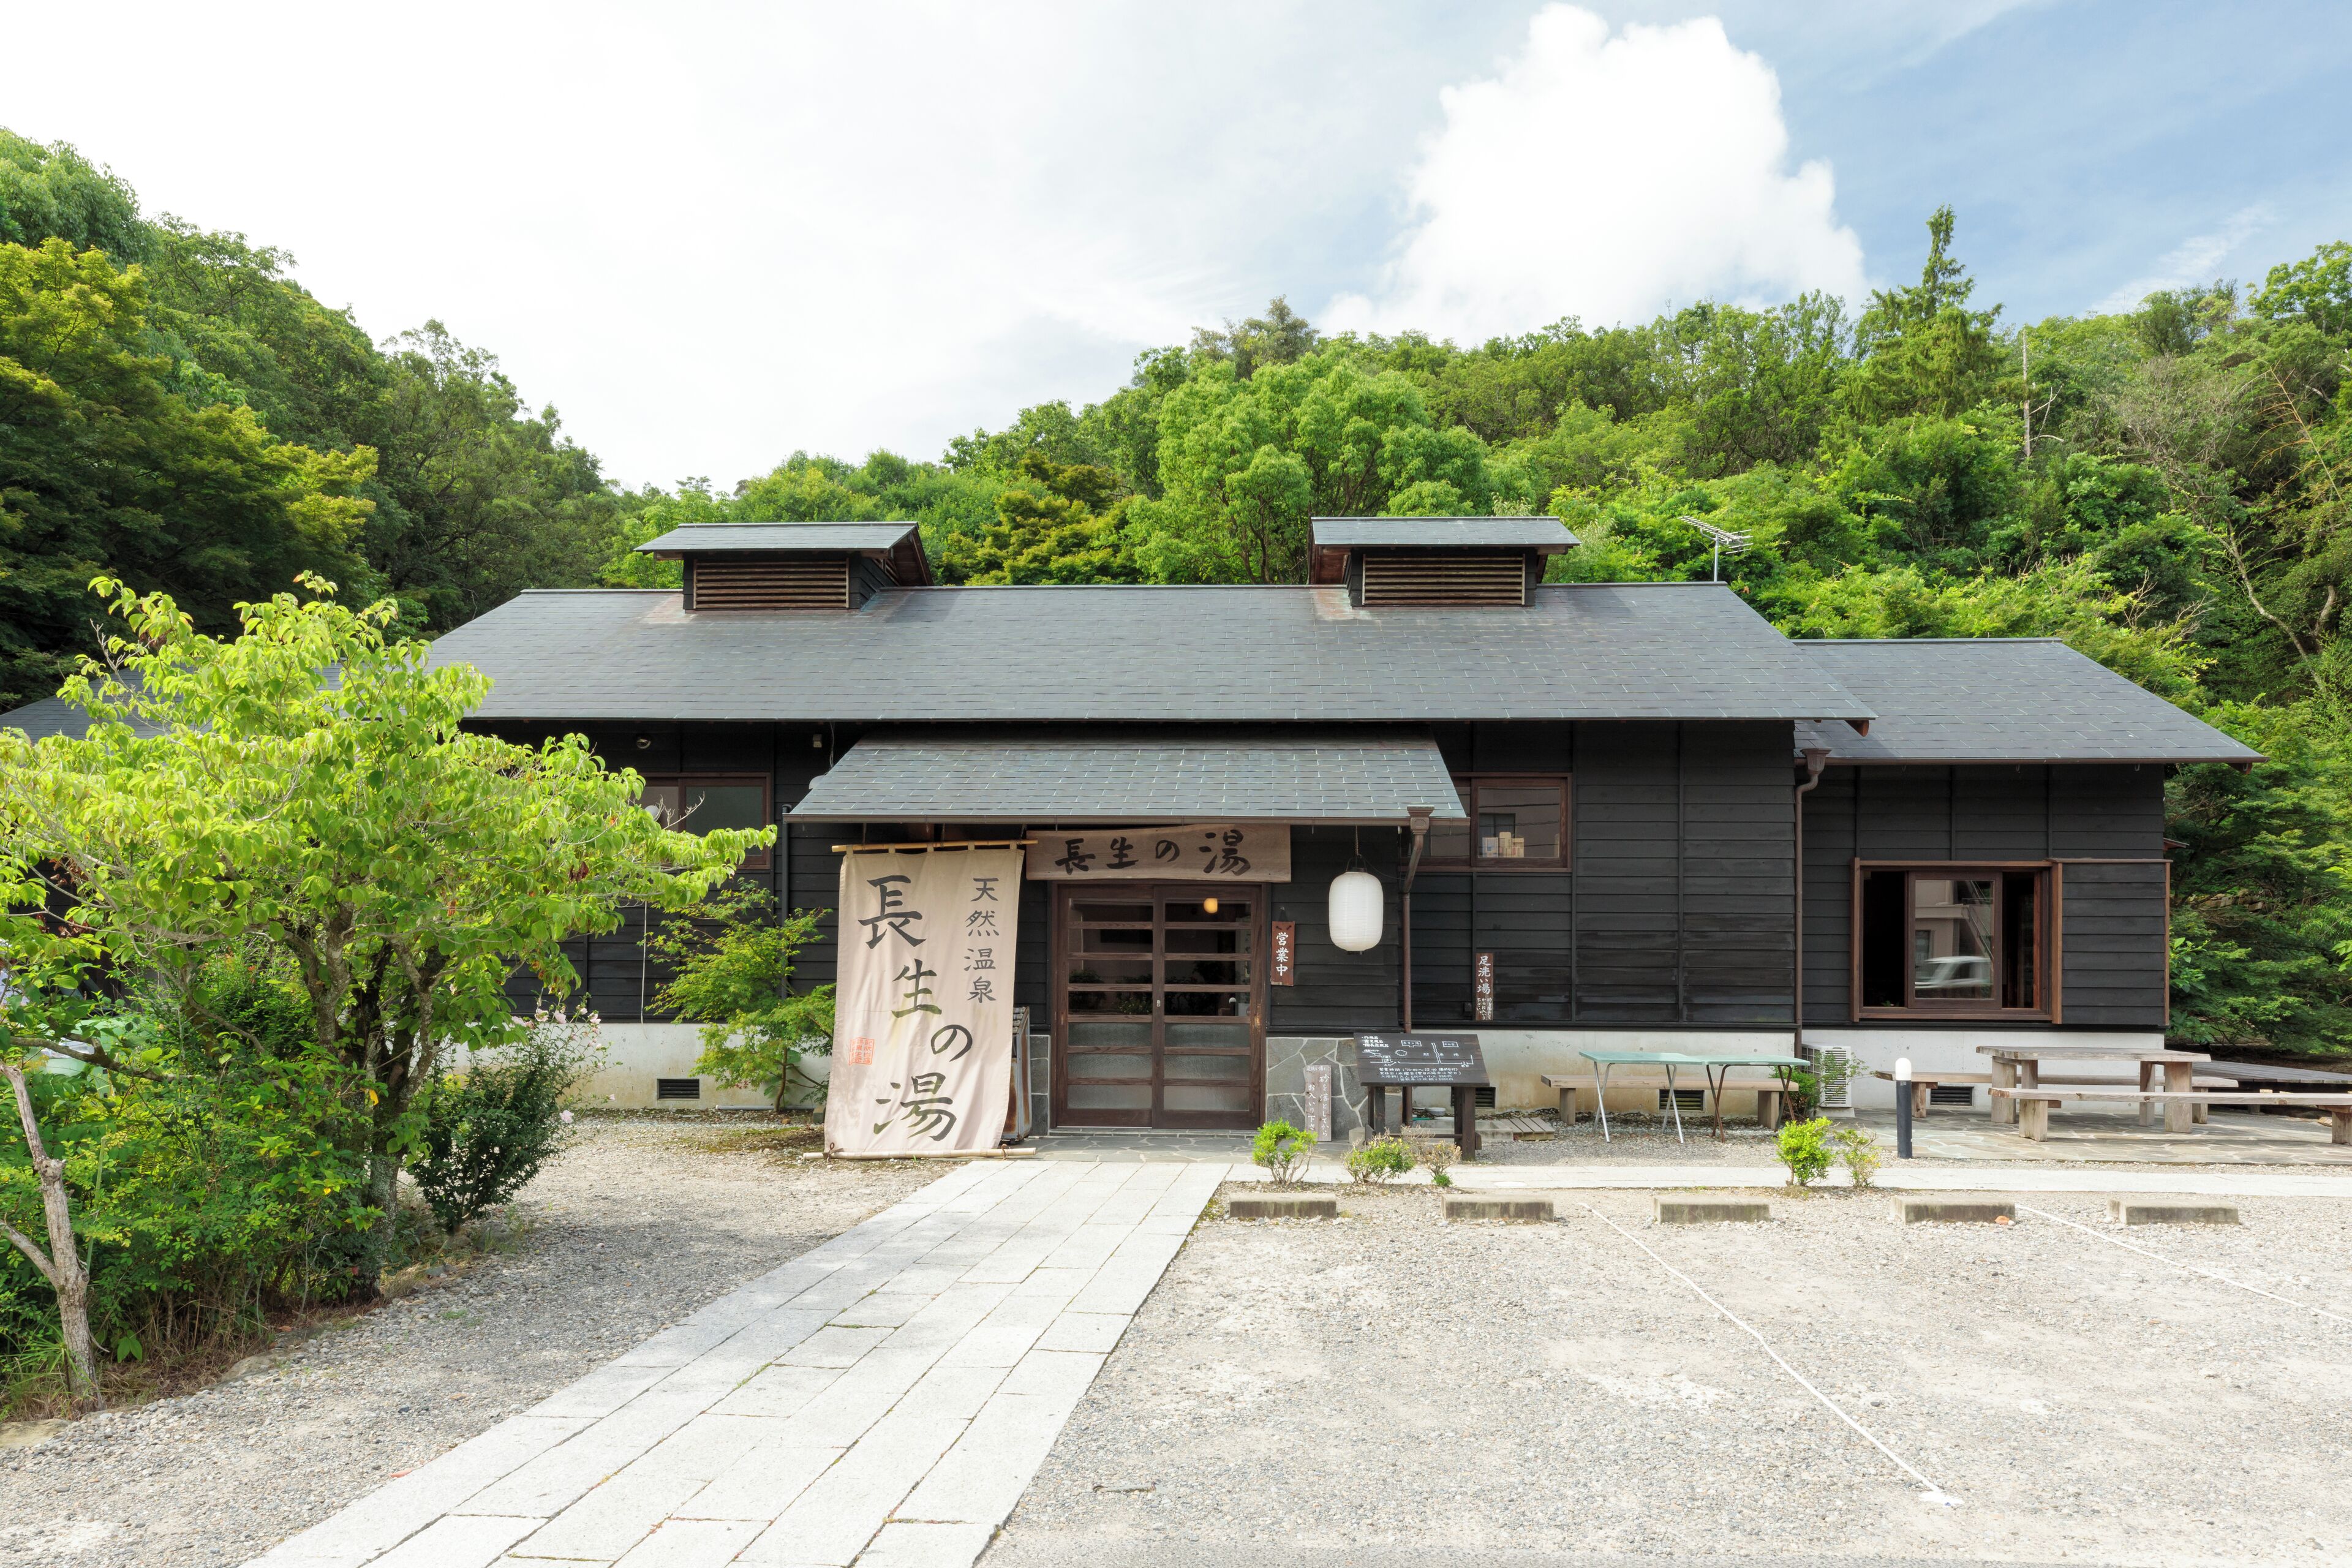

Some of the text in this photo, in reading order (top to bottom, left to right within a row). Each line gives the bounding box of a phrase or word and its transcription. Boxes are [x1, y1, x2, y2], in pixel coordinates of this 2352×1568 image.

[1054, 829, 1251, 876] 長生の湯
[963, 877, 1000, 1003] 天然温泉
[1275, 932, 1289, 976] 営業中
[1477, 956, 1491, 994] 足洗い場
[858, 875, 973, 1142] 長生の湯
[1308, 1084, 1317, 1131] お入いり下さ
[1319, 1074, 1330, 1137] 砂を落としてから
